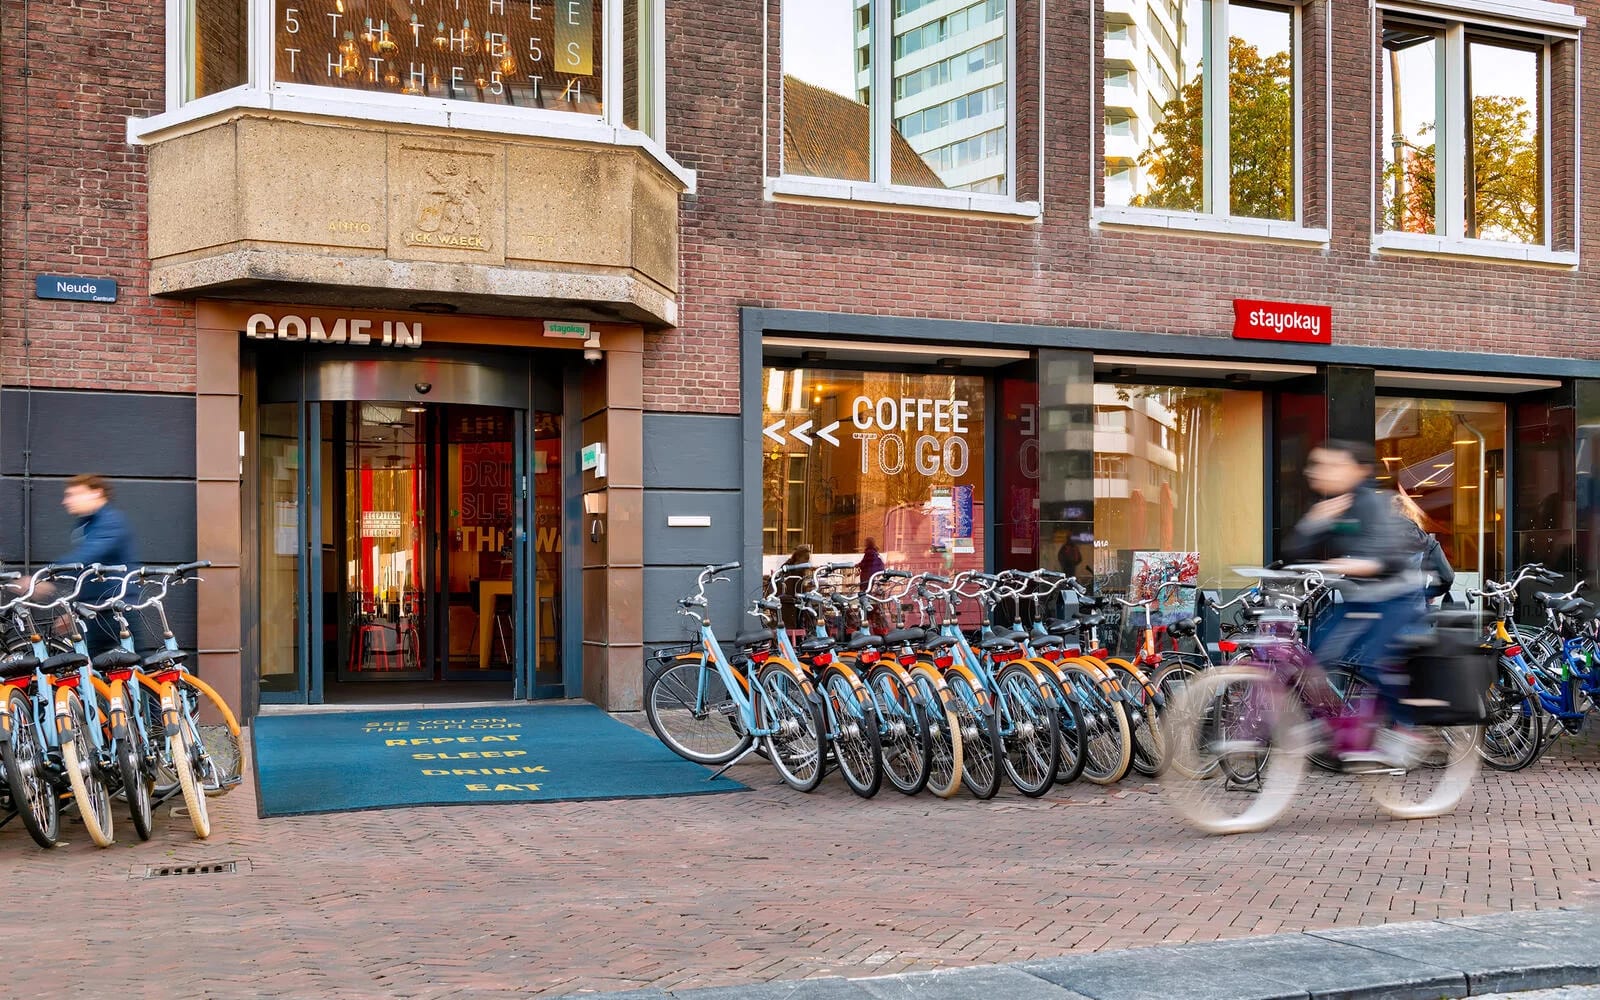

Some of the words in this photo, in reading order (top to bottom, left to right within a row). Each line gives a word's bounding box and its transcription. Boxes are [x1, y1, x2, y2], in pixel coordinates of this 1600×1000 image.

[328, 221, 371, 233] ANNO
[411, 232, 431, 243] ICK
[437, 234, 483, 247] WAECK
[57, 281, 97, 294] Neude
[1249, 308, 1320, 336] stayokay
[246, 313, 371, 345] COME
[381, 321, 423, 349] IN
[550, 323, 585, 336] stayokay
[852, 395, 969, 433] COFFEE
[852, 432, 905, 475] TO
[915, 434, 969, 478] GO
[385, 734, 521, 747] REPEAT
[411, 750, 528, 760] SLEEP
[421, 765, 550, 776] DRINK
[465, 783, 544, 791] EAT
